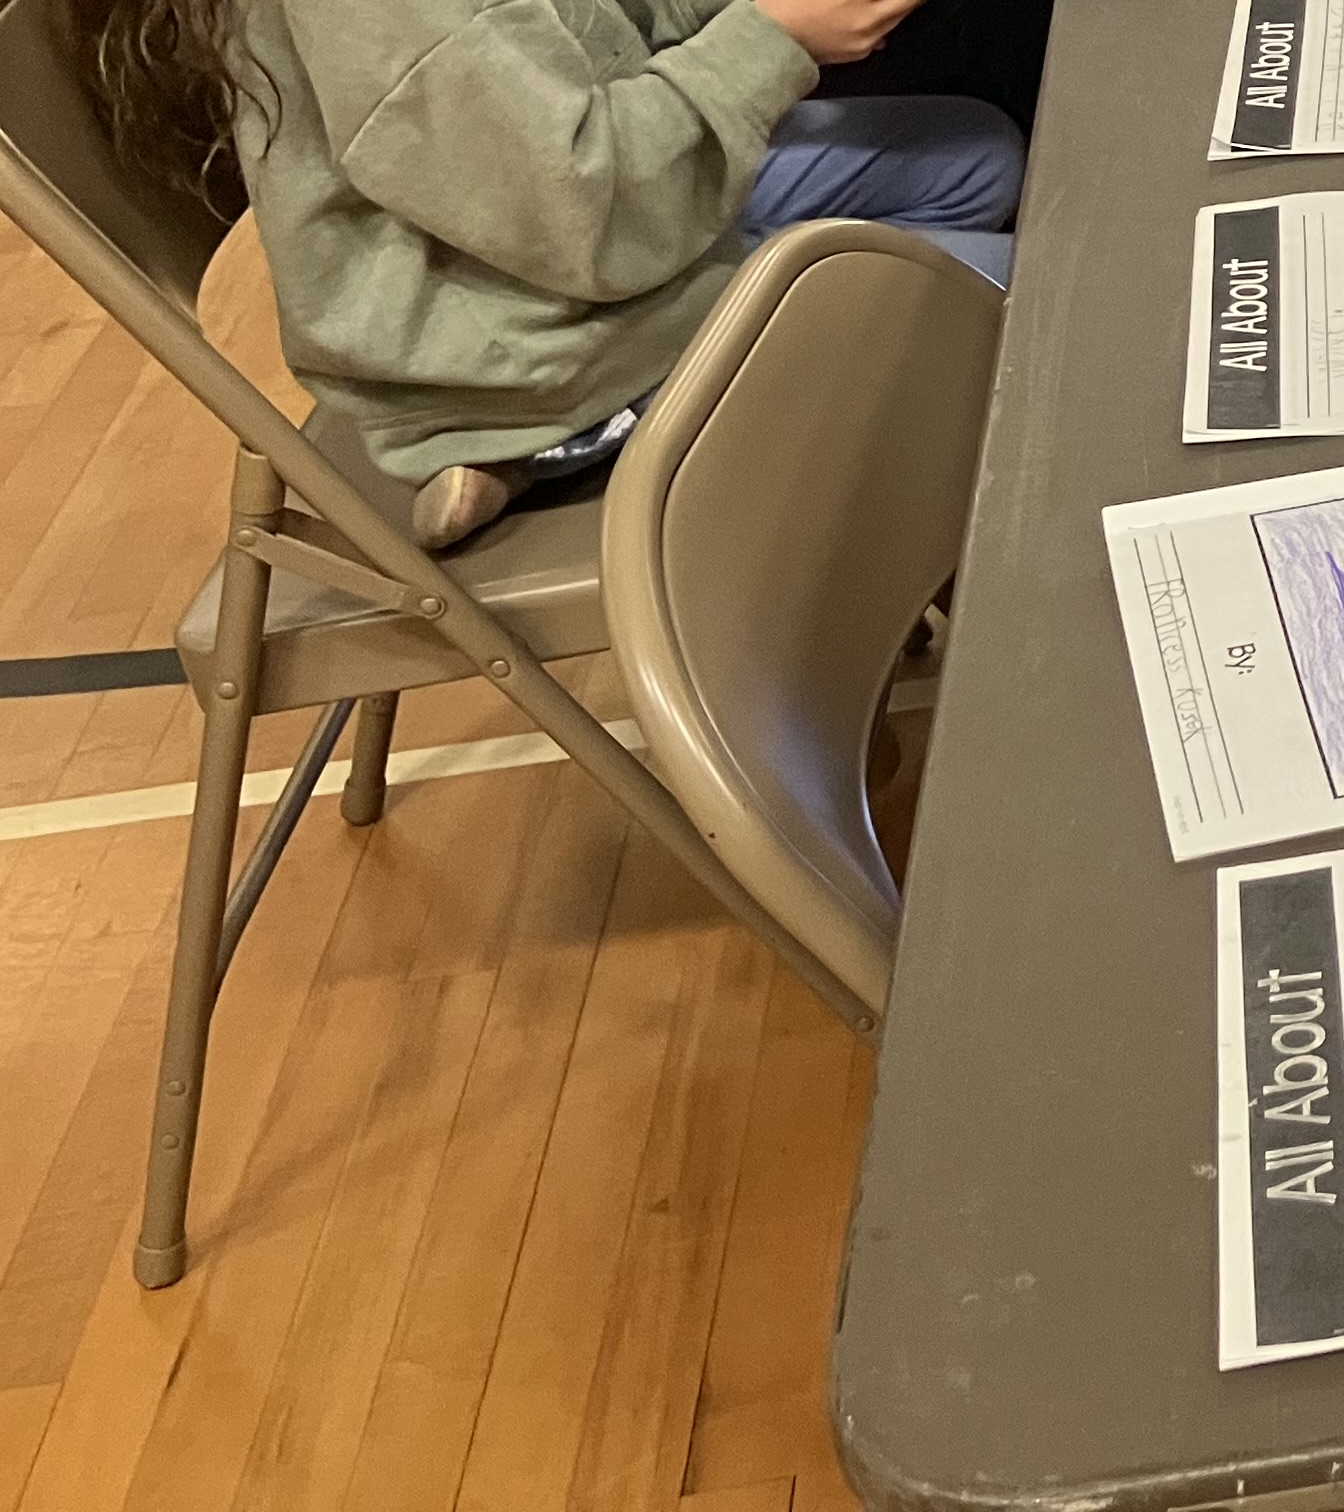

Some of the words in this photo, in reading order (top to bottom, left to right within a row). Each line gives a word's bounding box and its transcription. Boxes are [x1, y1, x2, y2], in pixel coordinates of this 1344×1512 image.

[1250, 21, 1295, 81] About
[1245, 85, 1287, 109] All
[1221, 258, 1269, 335] About
[1219, 340, 1268, 372] All
[1224, 643, 1256, 675] By:
[1257, 968, 1331, 1125] About
[1264, 1139, 1338, 1205] All
